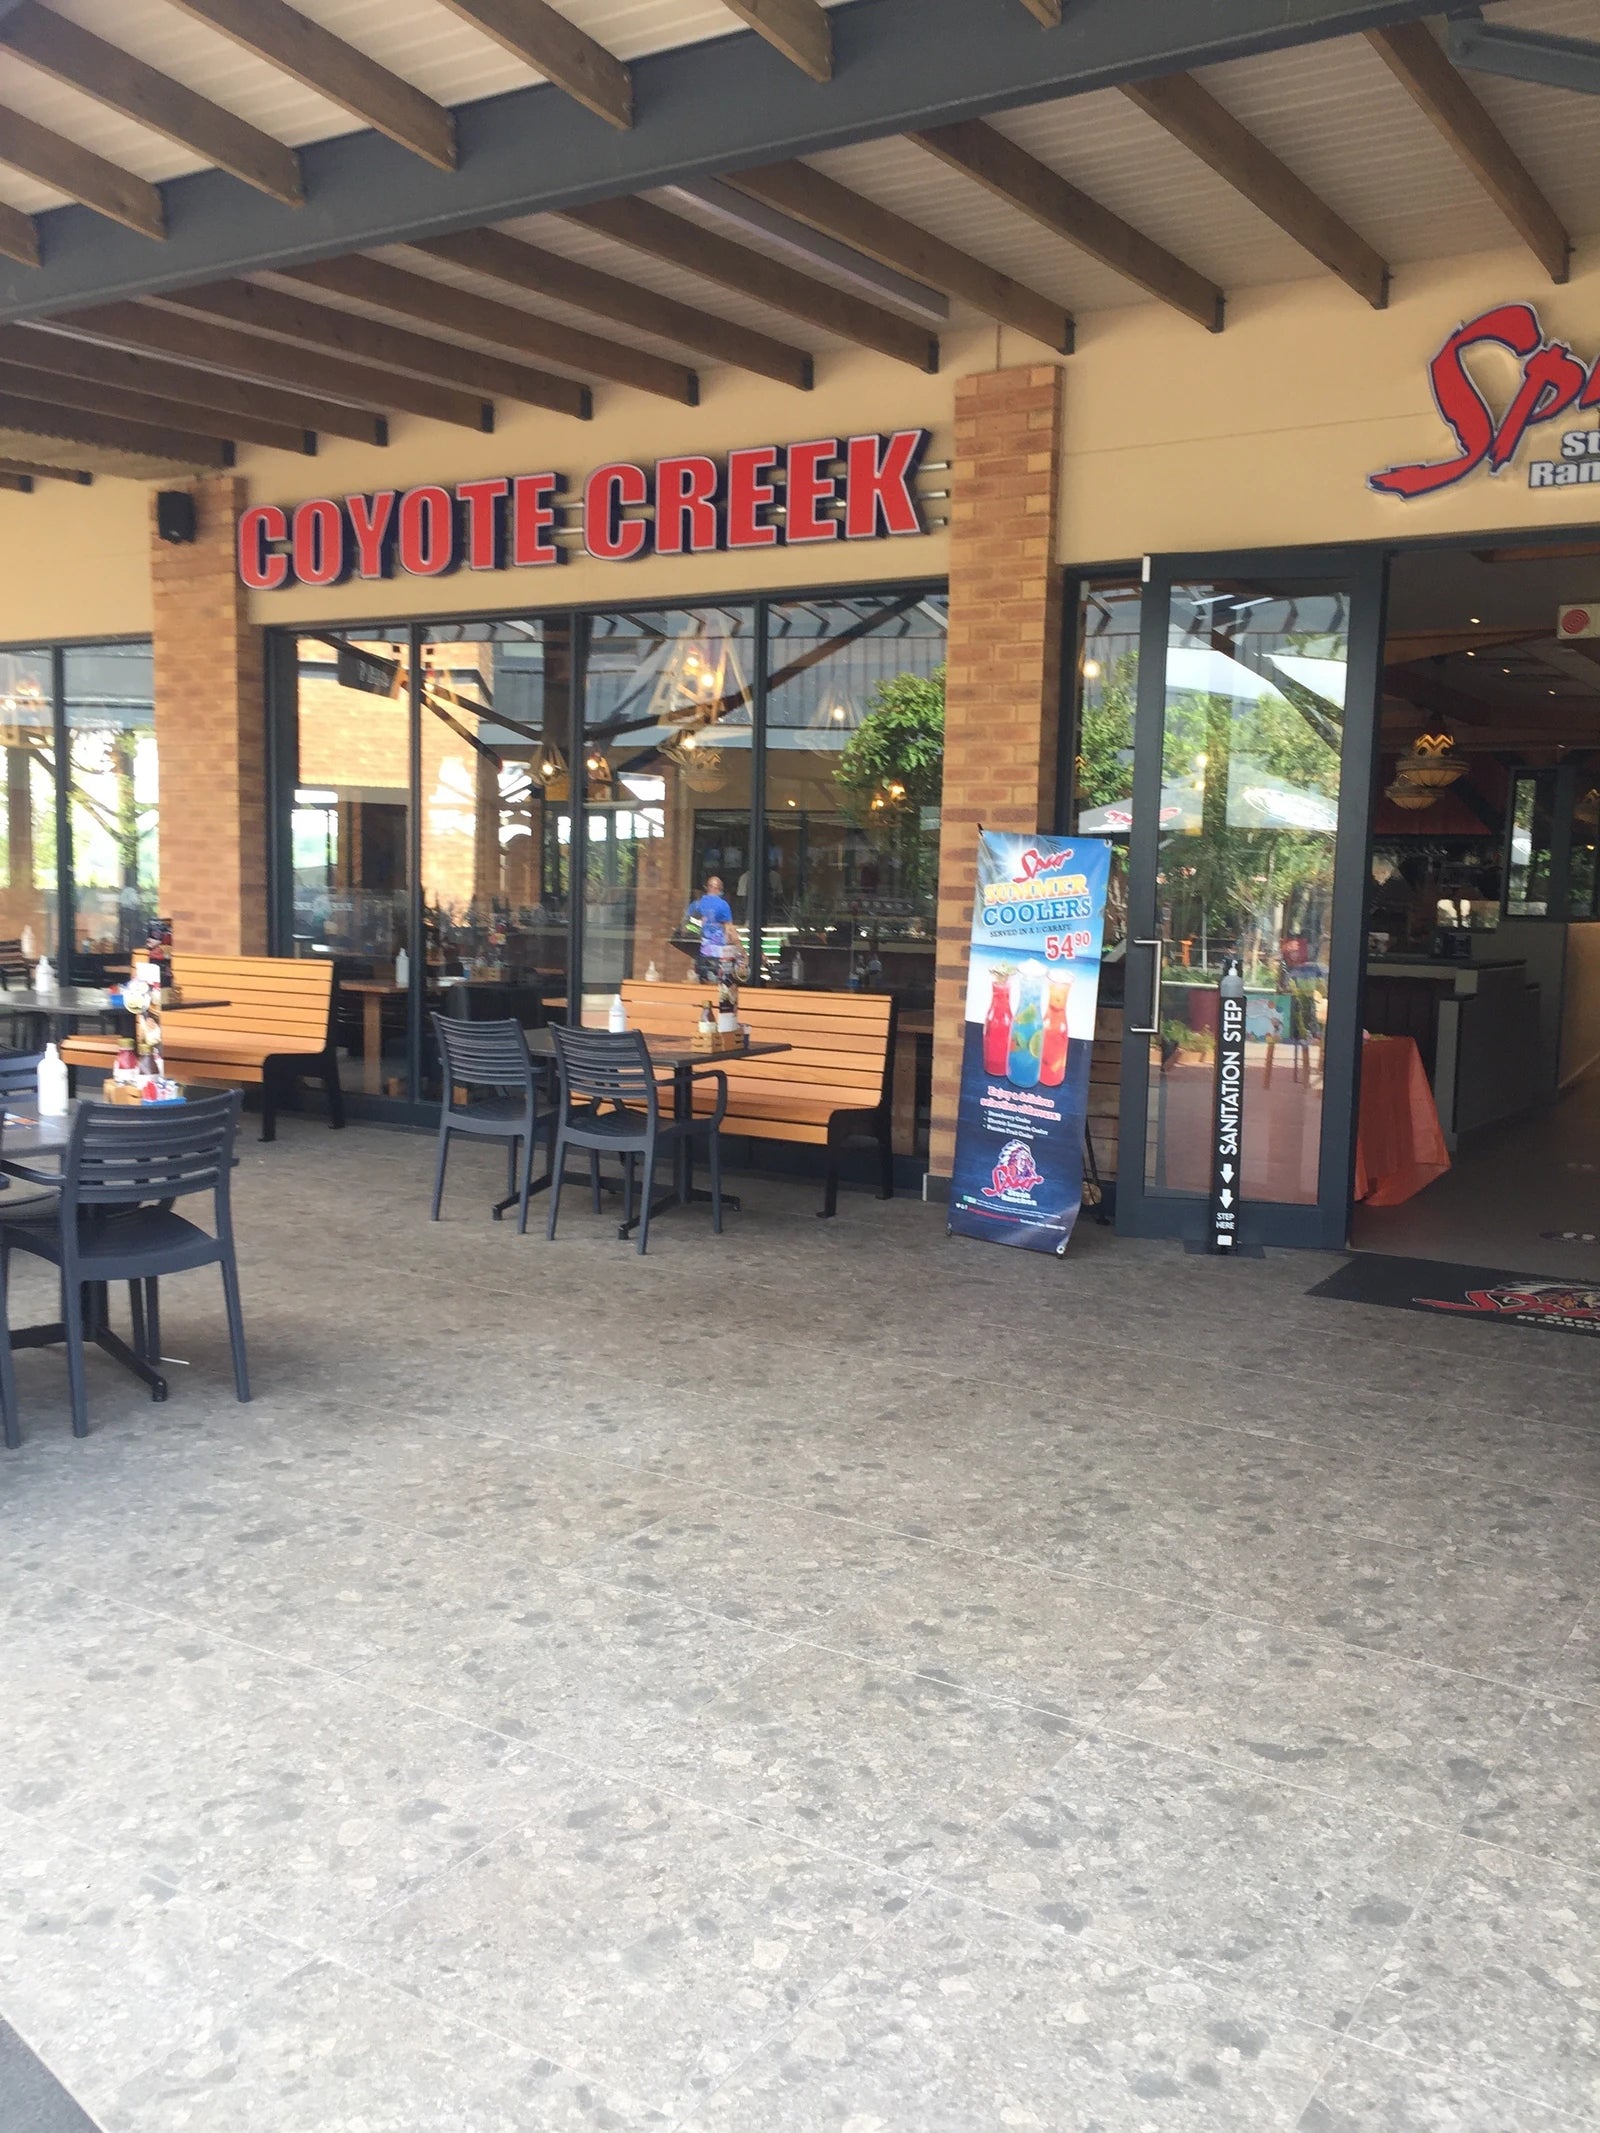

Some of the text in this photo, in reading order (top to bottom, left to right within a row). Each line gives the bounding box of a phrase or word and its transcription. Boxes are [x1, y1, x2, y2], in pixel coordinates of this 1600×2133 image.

[238, 428, 928, 591] COYOTE CREEK
[1012, 848, 1074, 884] Spur
[984, 874, 1089, 905] SUMMER
[983, 897, 1092, 926] COOLERS
[1219, 999, 1242, 1156] SANITATION STEP
[1215, 1221, 1235, 1230] HERE
[1216, 1212, 1235, 1221] STEP
